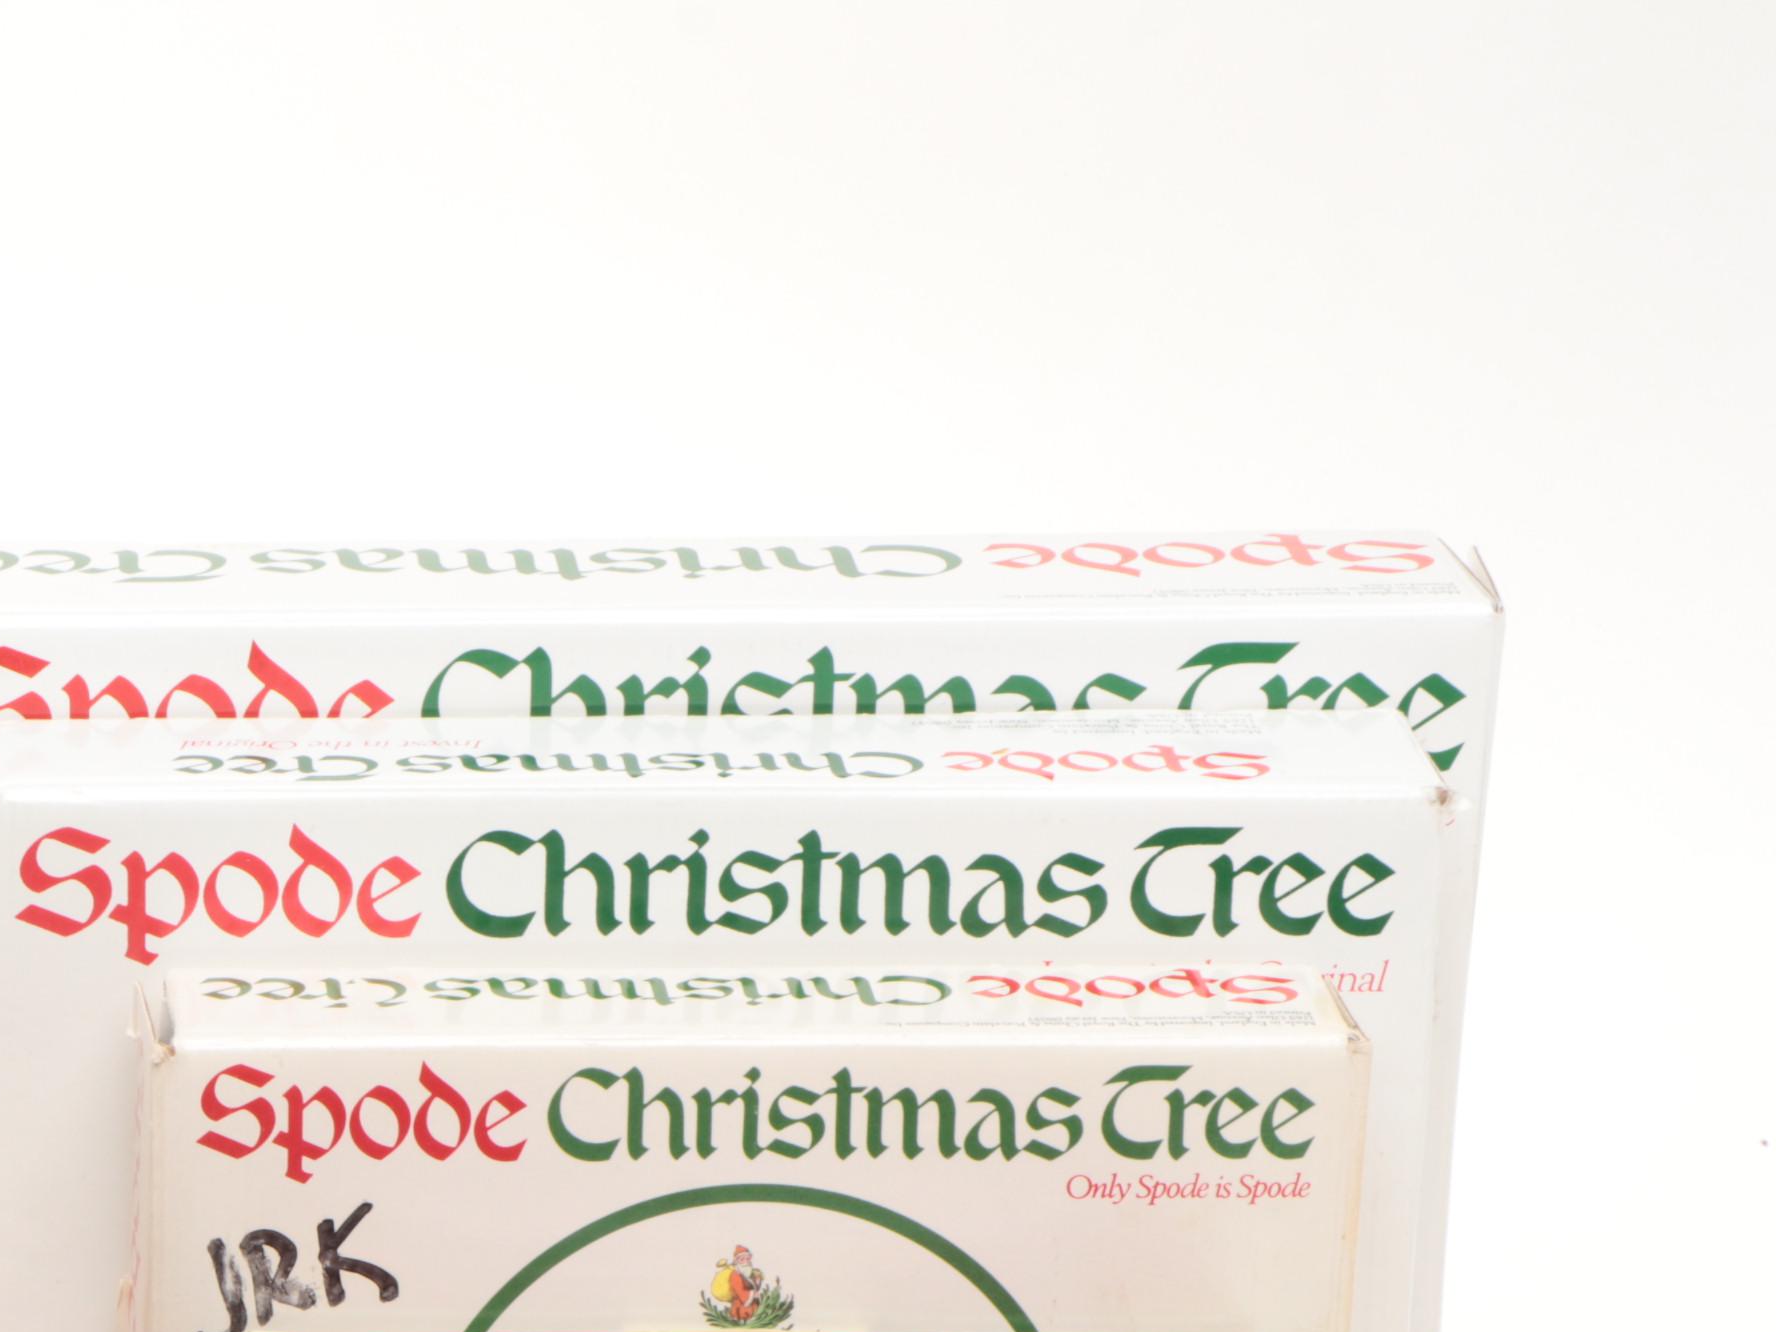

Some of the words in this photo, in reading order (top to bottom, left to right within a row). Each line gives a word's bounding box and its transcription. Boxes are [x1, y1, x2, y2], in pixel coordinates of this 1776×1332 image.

[250, 542, 962, 582] Christmas
[984, 534, 1436, 578] Spode
[174, 754, 379, 782] Tree
[396, 750, 924, 780] Christmas
[944, 744, 1271, 782] Spode
[14, 823, 422, 967] Spode
[445, 828, 1109, 940] Christmas
[1129, 826, 1396, 938] Tree
[423, 974, 952, 1008] Christmas
[968, 968, 1299, 1008] Spode
[196, 1061, 528, 1184] Spode
[546, 1066, 1084, 1162] Christmas
[1101, 1065, 1316, 1161] Tree
[1065, 1173, 1132, 1204] Only
[1135, 1173, 1209, 1206] Spode
[1215, 1175, 1233, 1200] is
[1236, 1172, 1312, 1205] Spode
